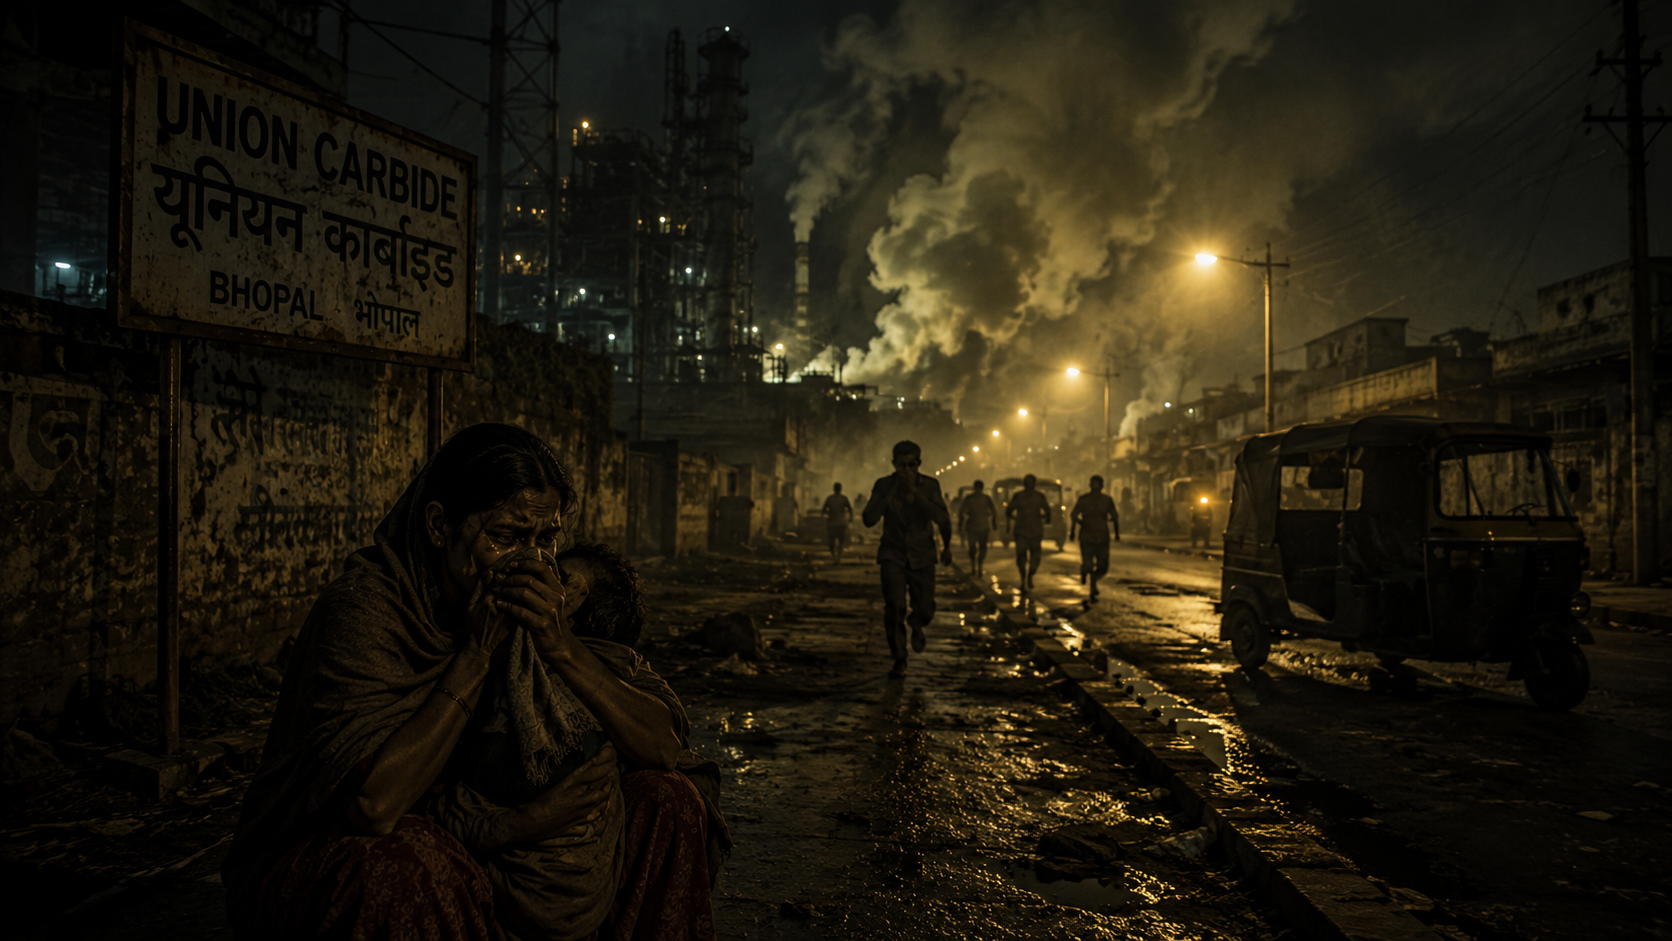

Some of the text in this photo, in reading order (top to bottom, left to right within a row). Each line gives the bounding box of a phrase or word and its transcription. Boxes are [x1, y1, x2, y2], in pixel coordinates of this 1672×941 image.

[157, 75, 458, 220] UNION CARBIDE
[151, 155, 457, 292] यूनियन कार्बाइड
[210, 270, 323, 321] BHOPAL
[354, 291, 421, 338] भोपाल
